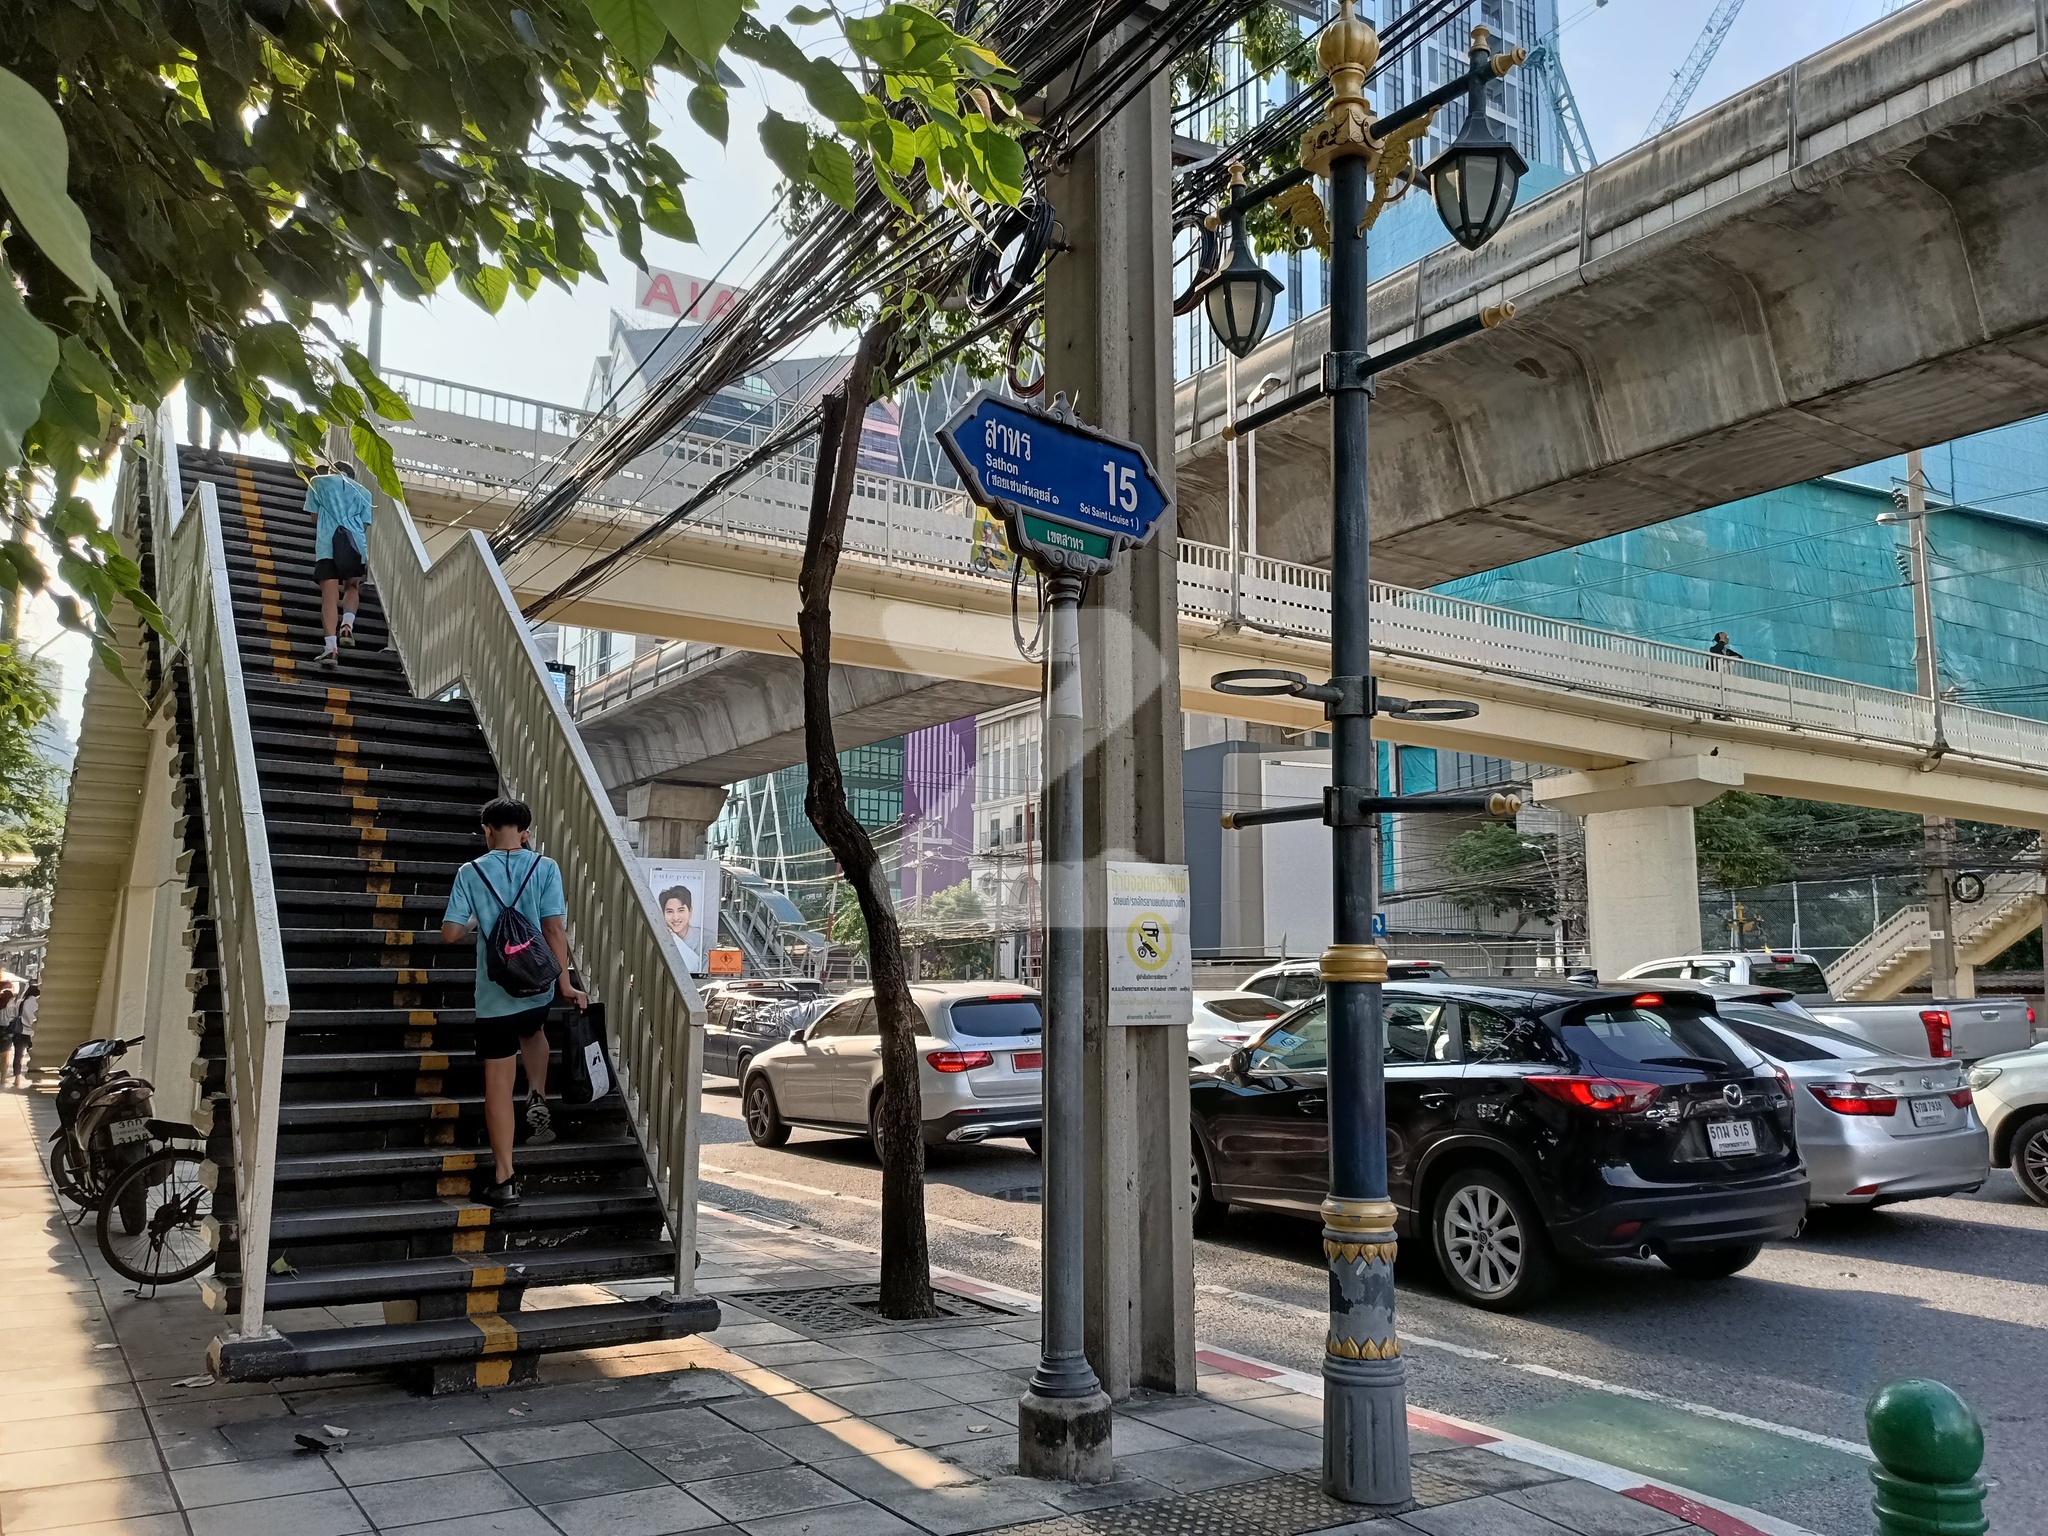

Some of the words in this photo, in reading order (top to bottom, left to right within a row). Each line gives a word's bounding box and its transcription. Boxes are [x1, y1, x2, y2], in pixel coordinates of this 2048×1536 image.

[641, 273, 739, 320] AIA
[985, 418, 1031, 461] สาทร
[985, 453, 1019, 475] Sathon
[1103, 460, 1138, 512] 15
[1080, 502, 1090, 515] Soi
[1092, 506, 1108, 520] Saint
[1109, 512, 1130, 526] Louise
[1047, 530, 1084, 551] เขตสาทร
[1646, 1108, 1678, 1118] CX-5
[1733, 1123, 1750, 1137] 615
